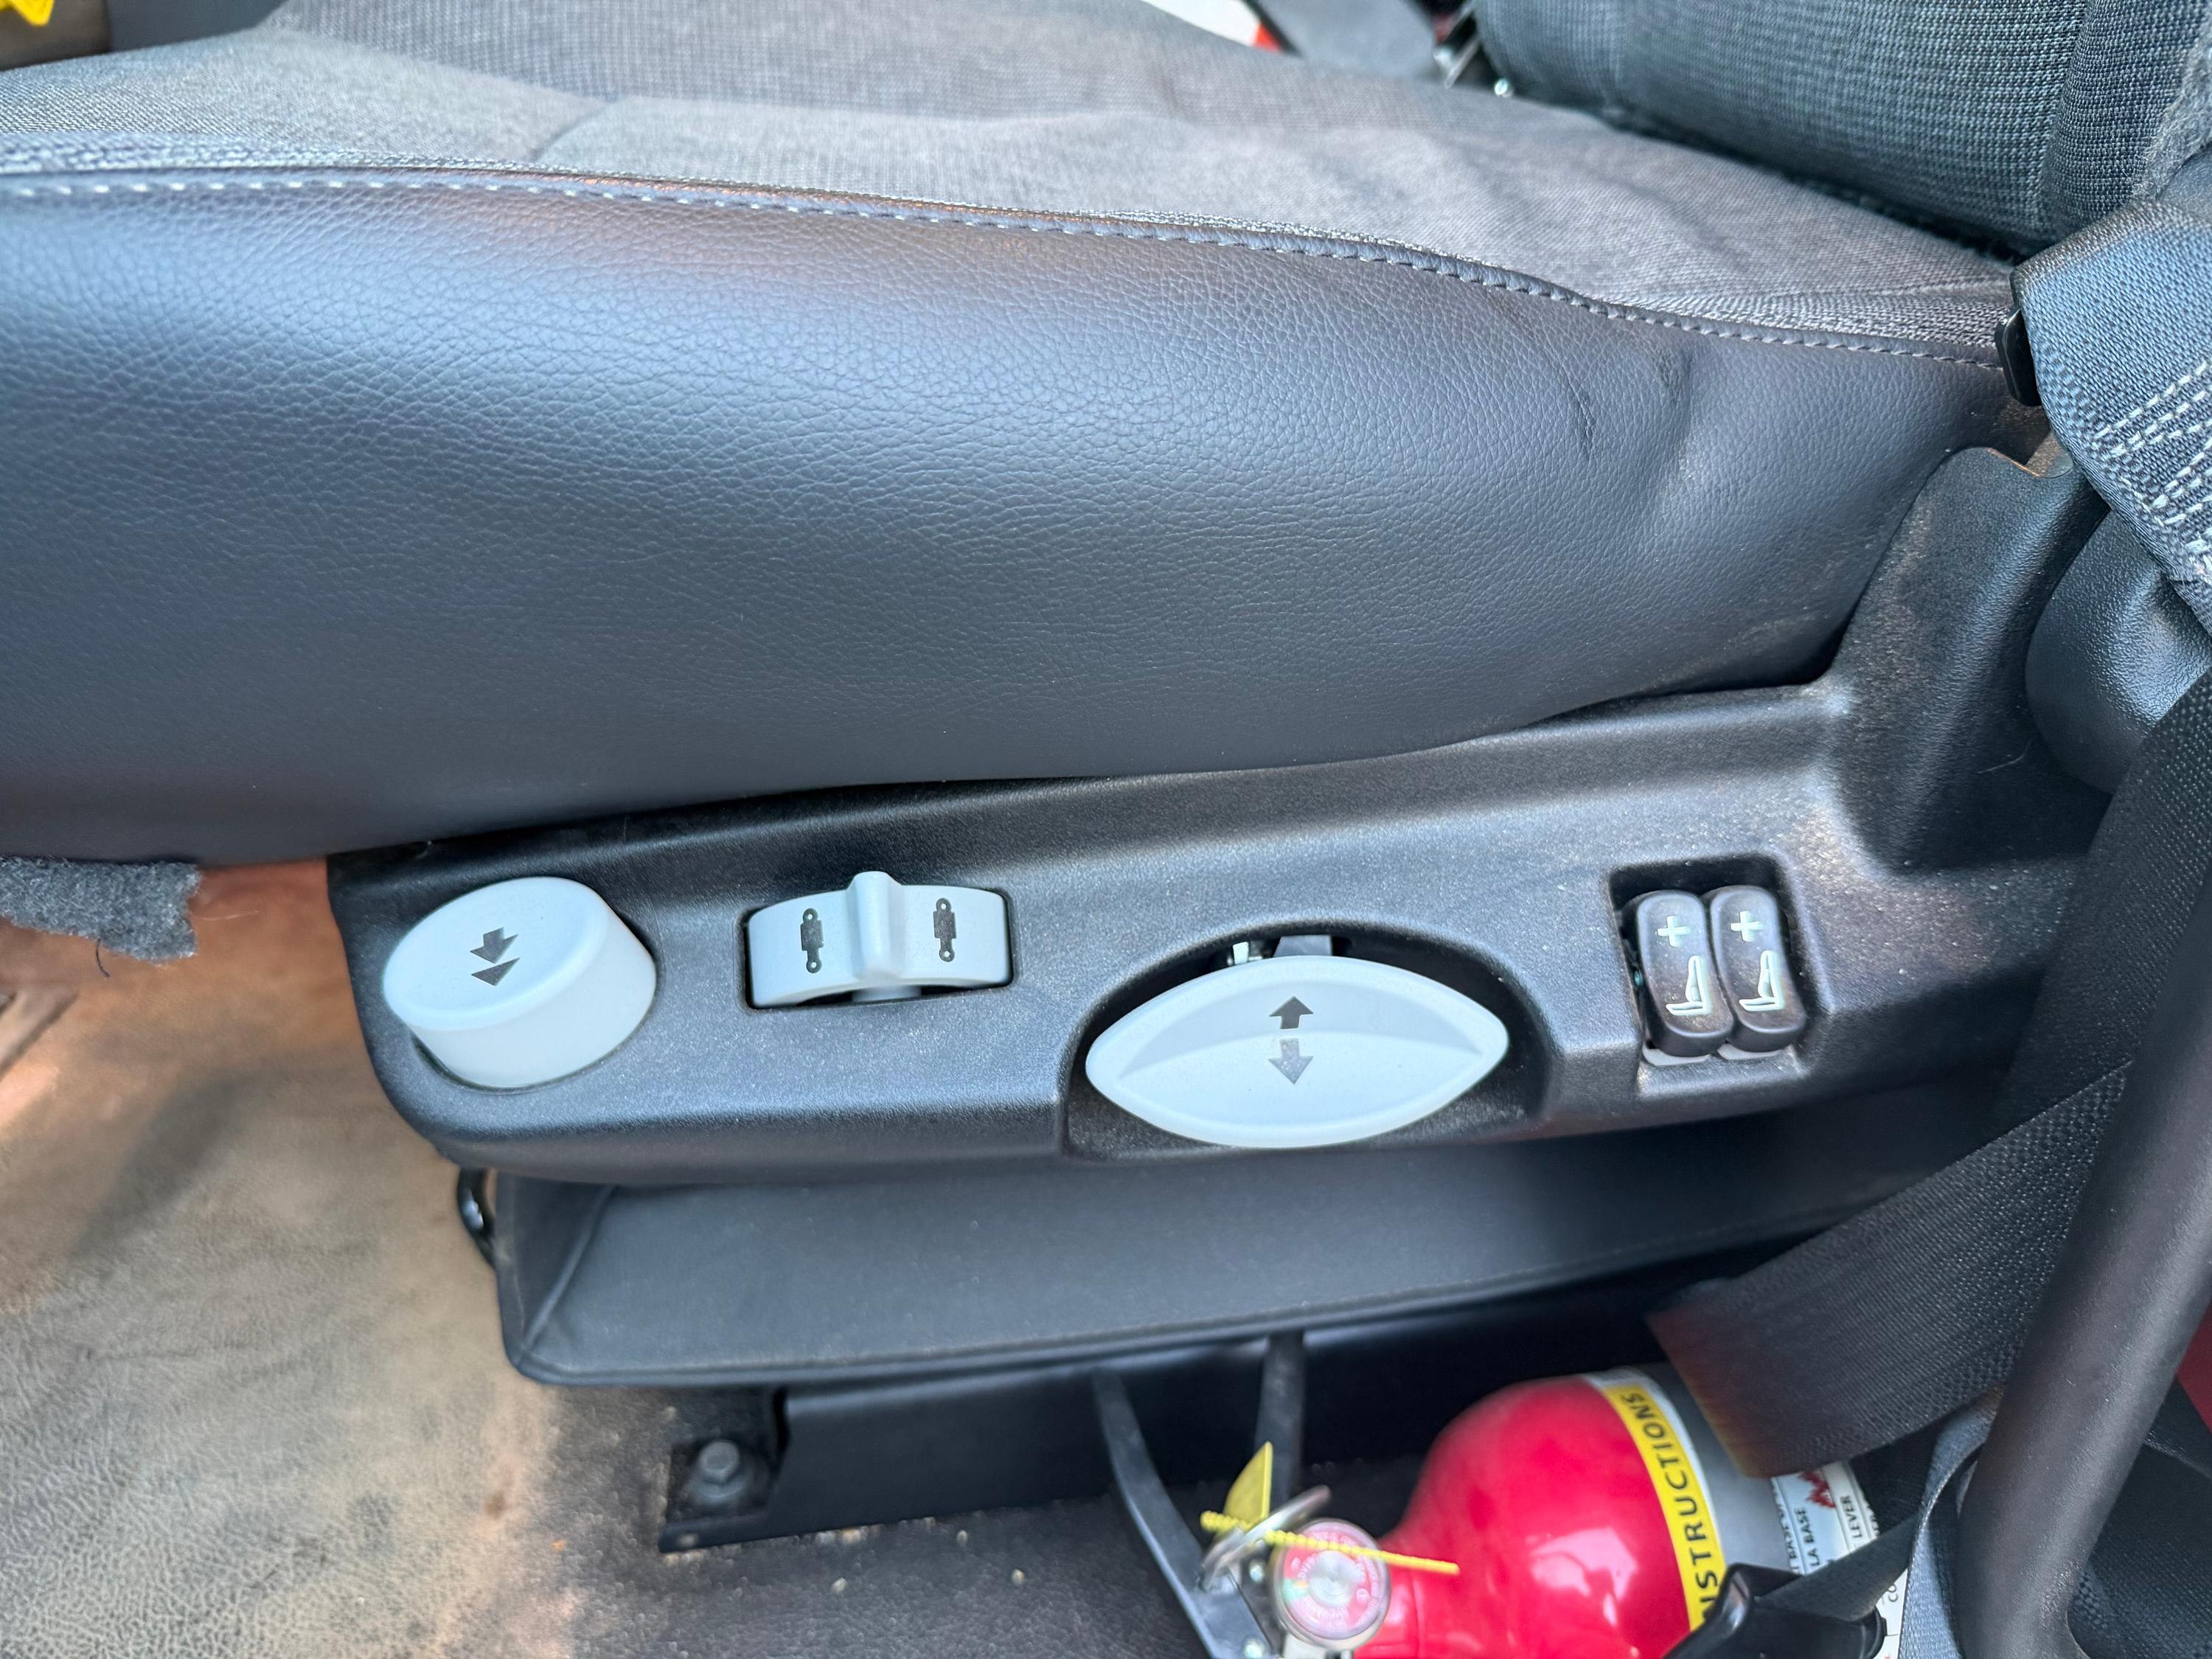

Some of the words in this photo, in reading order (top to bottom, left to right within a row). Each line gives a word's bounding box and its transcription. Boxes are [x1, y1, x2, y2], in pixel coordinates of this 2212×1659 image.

[1795, 1509, 1814, 1543] BASE
[1840, 1496, 1863, 1538] LEVER
[1808, 1548, 1820, 1565] LA
